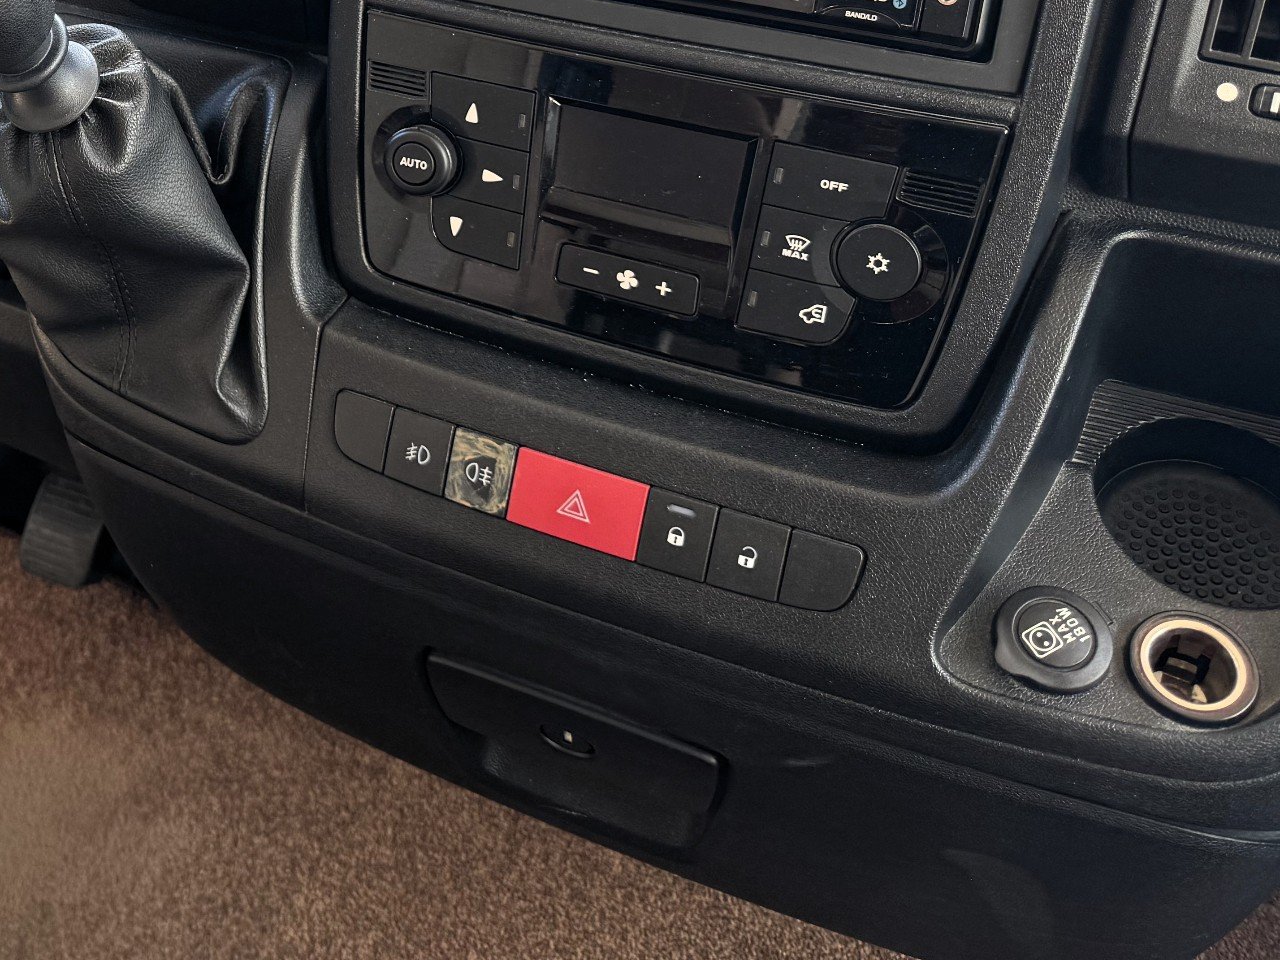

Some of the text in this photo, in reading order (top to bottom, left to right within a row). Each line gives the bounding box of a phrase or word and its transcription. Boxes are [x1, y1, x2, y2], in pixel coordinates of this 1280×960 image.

[400, 156, 428, 170] AUTO
[820, 179, 849, 192] OFF
[781, 248, 809, 261] MAX
[1049, 615, 1077, 644] MAX
